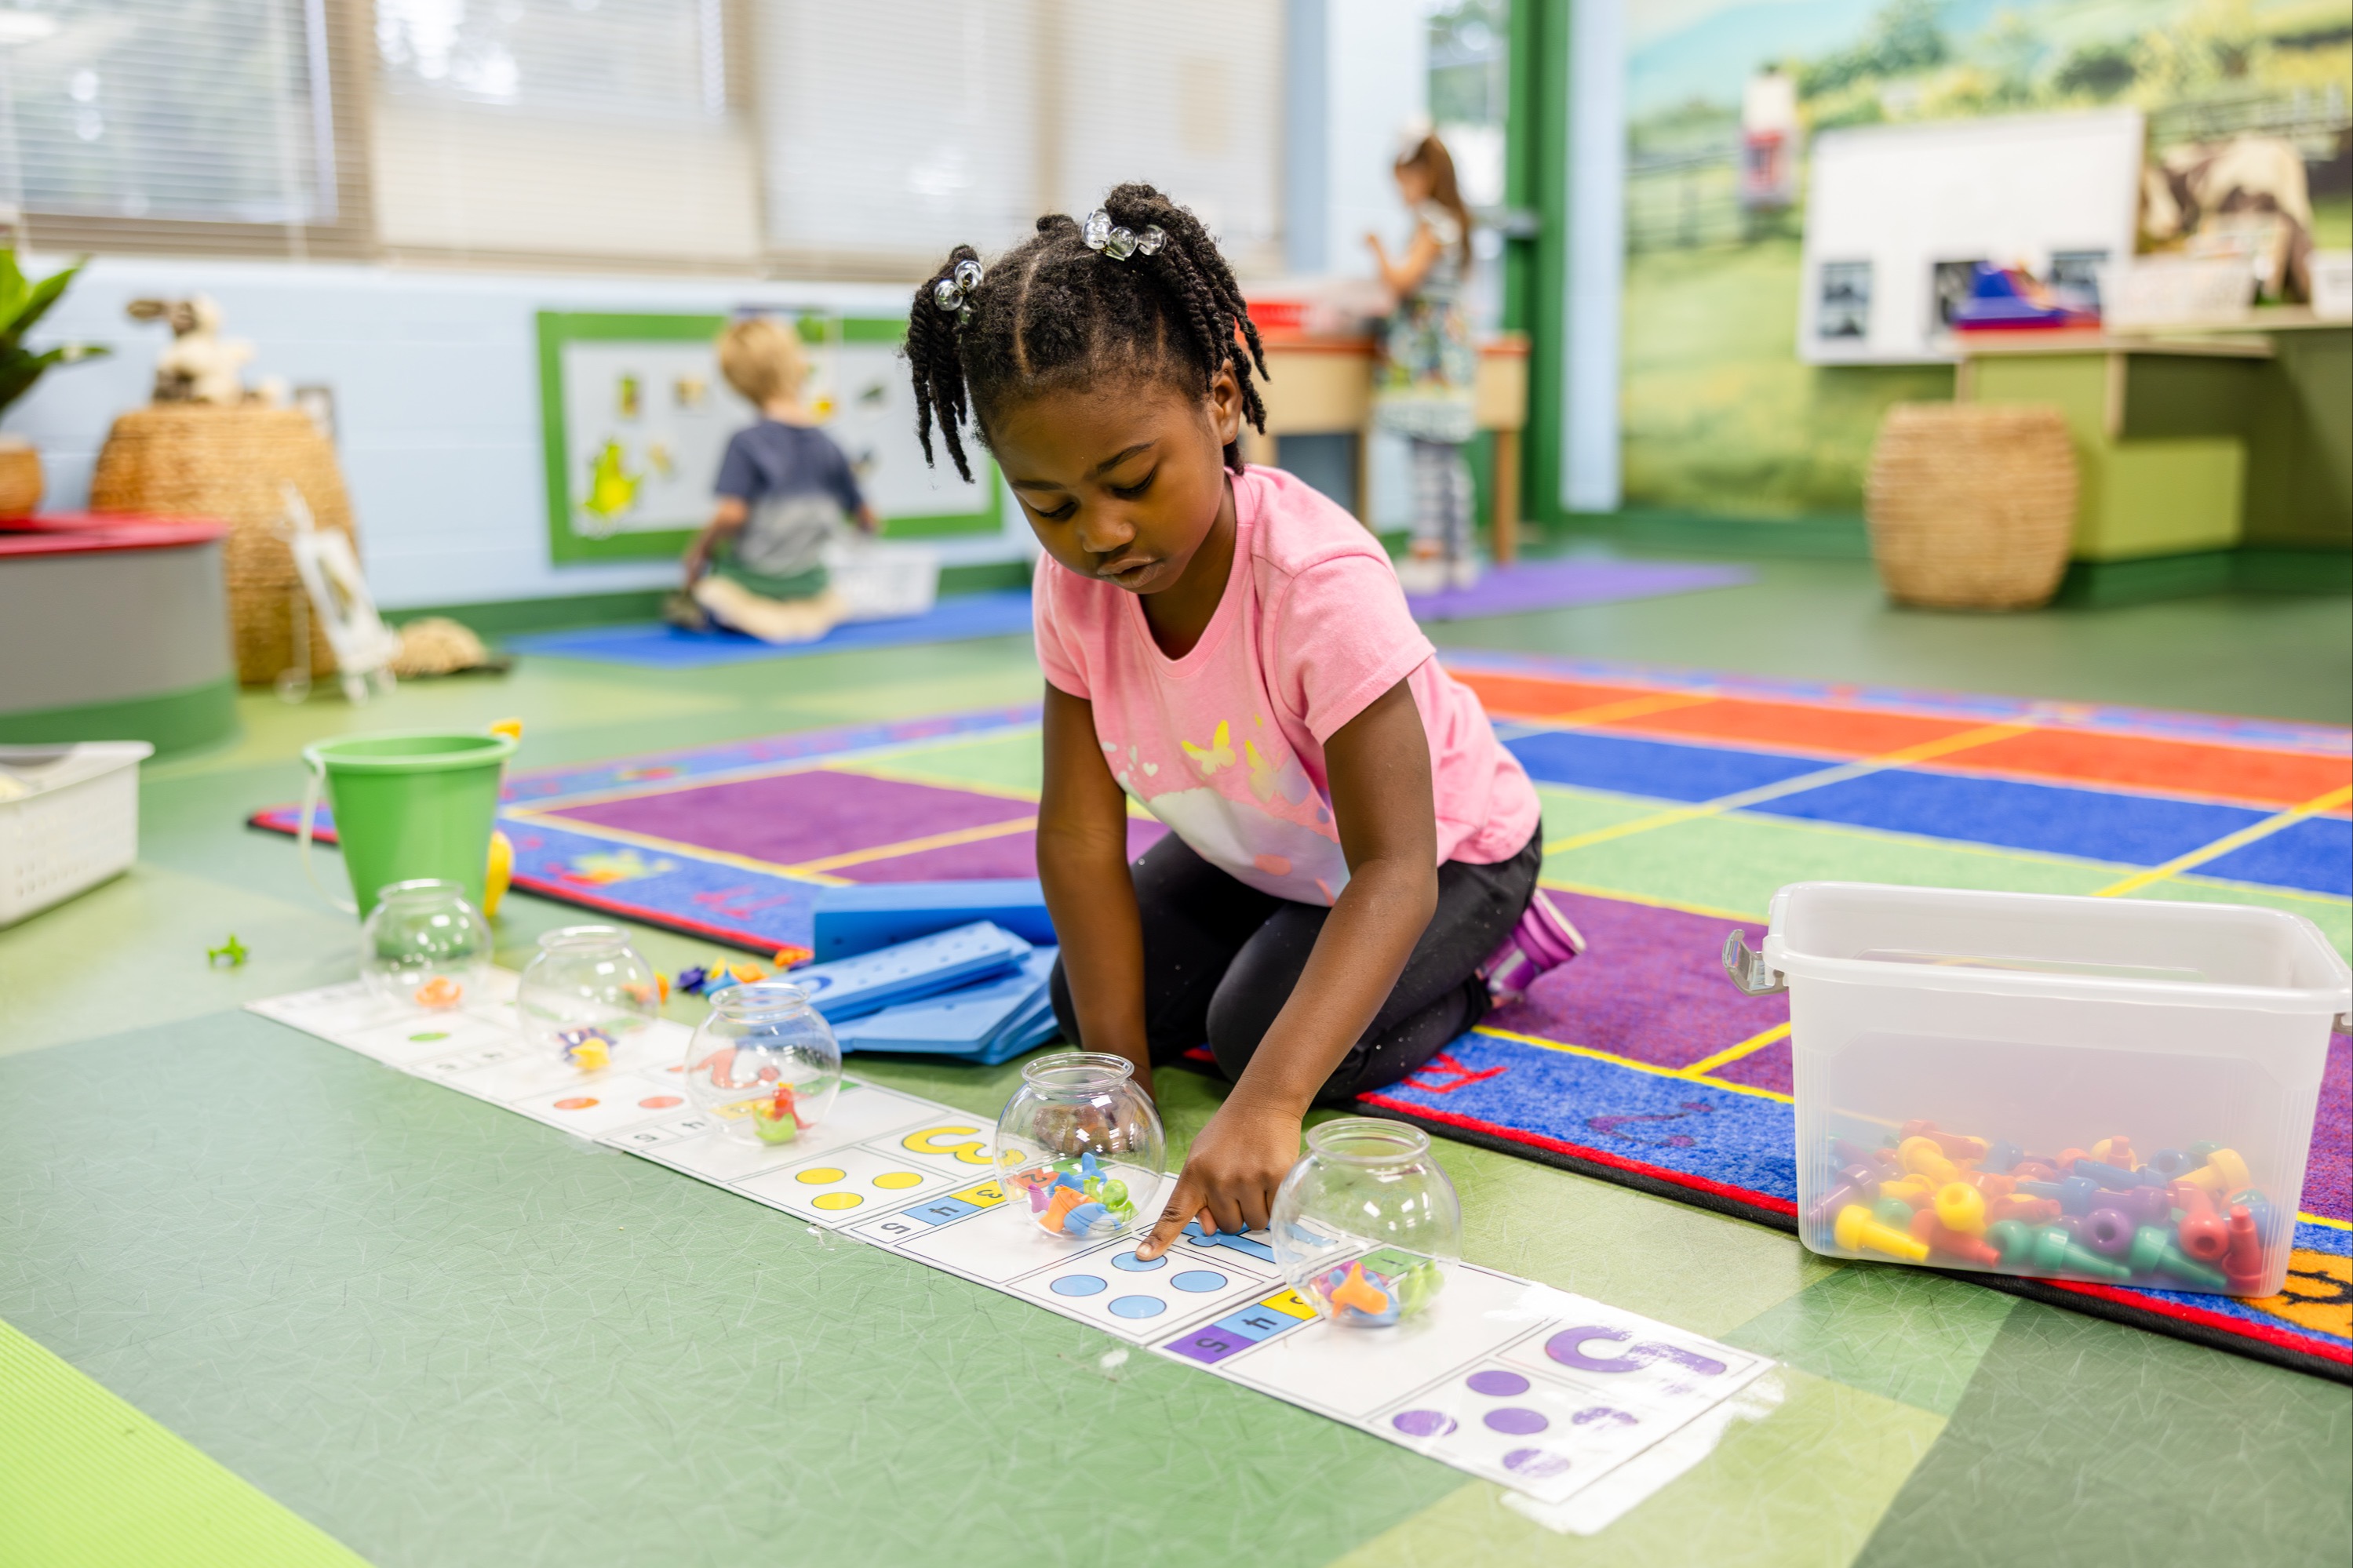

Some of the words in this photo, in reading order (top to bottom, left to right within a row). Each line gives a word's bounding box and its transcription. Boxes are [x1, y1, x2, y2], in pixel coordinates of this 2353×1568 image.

[901, 1126, 1027, 1166] 3
[1021, 1173, 1047, 1184] 2
[976, 1188, 1003, 1199] 3
[927, 1206, 960, 1217] 4
[880, 1222, 912, 1235] 5
[1241, 1316, 1277, 1330] 4
[1195, 1337, 1229, 1354] 5
[1544, 1326, 1728, 1377] 5
